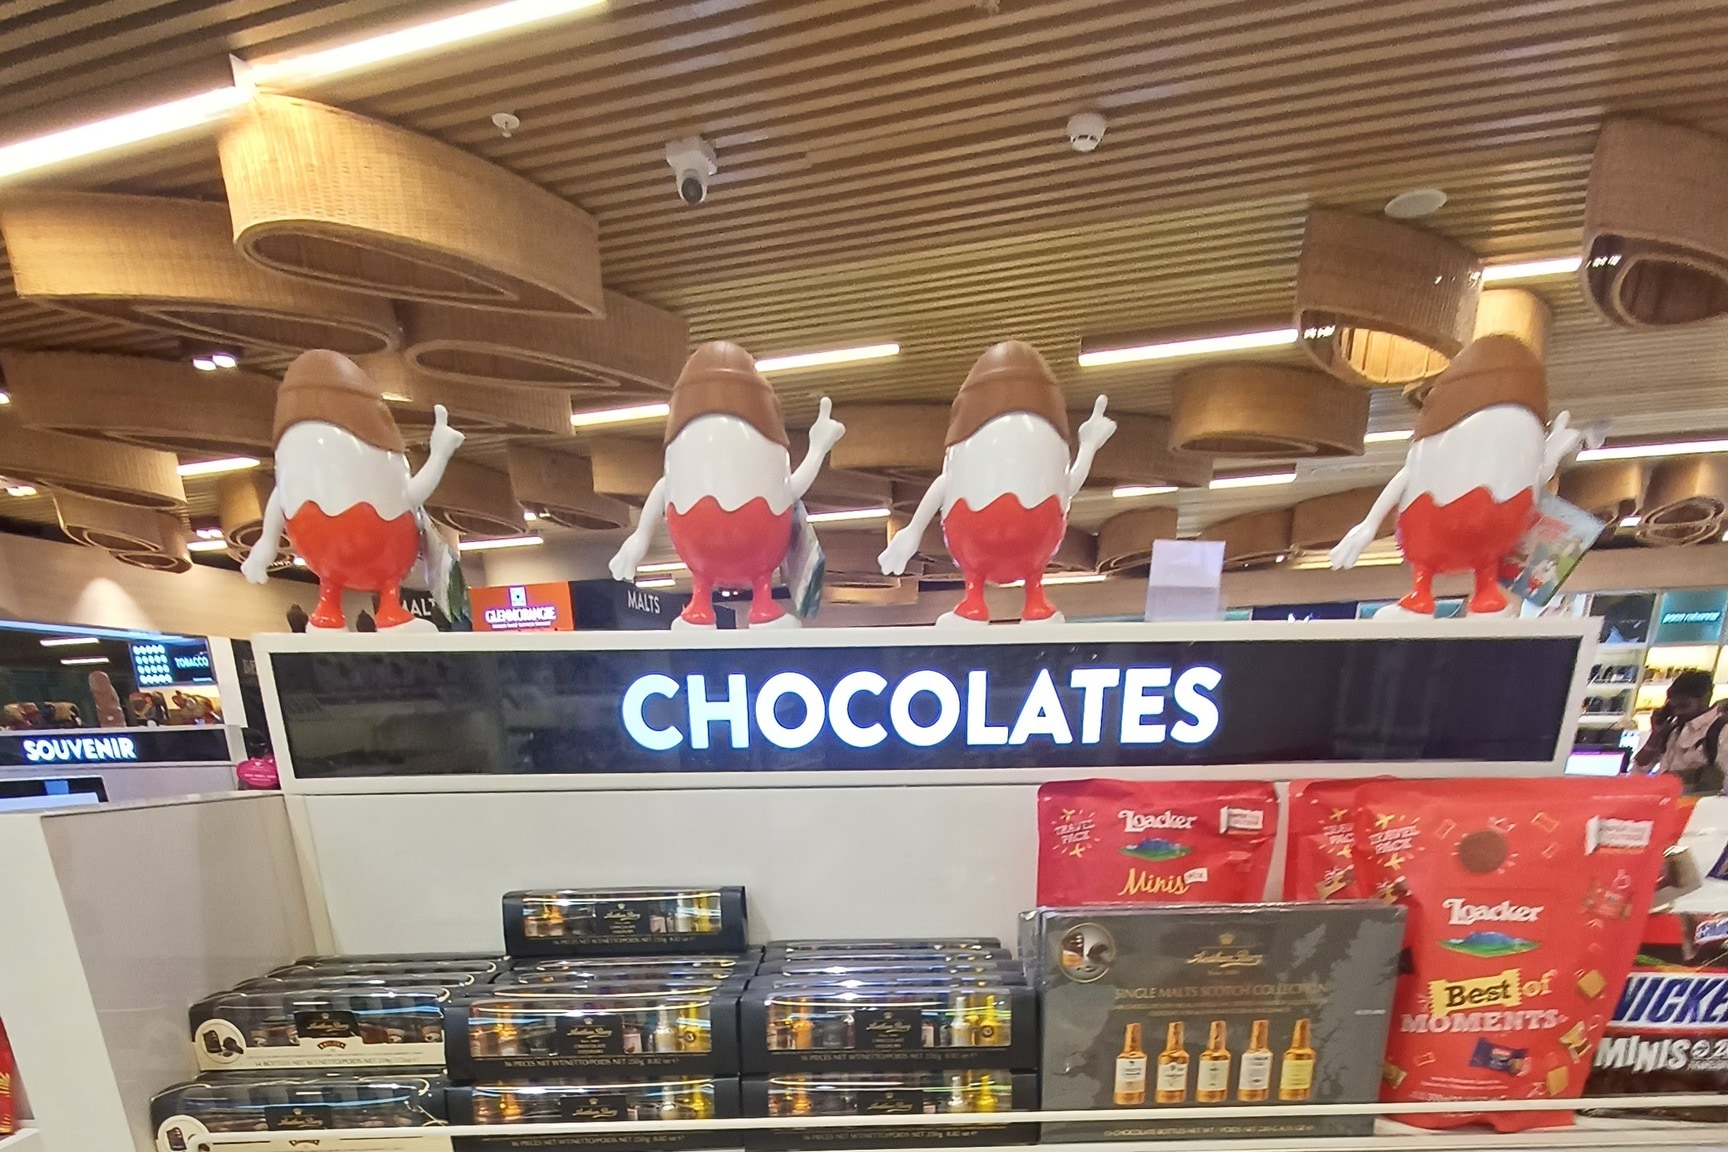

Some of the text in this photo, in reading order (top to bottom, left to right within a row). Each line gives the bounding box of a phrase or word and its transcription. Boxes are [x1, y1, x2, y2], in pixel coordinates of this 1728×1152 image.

[627, 591, 661, 614] MALTS
[174, 656, 209, 669] TOBACCO
[621, 666, 1223, 750] CHOCOLATES
[23, 737, 137, 761] SOUVENIR
[1118, 809, 1198, 833] Loacker
[1118, 868, 1190, 896] Minis
[1442, 898, 1544, 925] Loacker
[1446, 970, 1558, 1008] Best of
[1400, 1010, 1560, 1034] MOMENTS
[1594, 1035, 1692, 1075] MINIS
